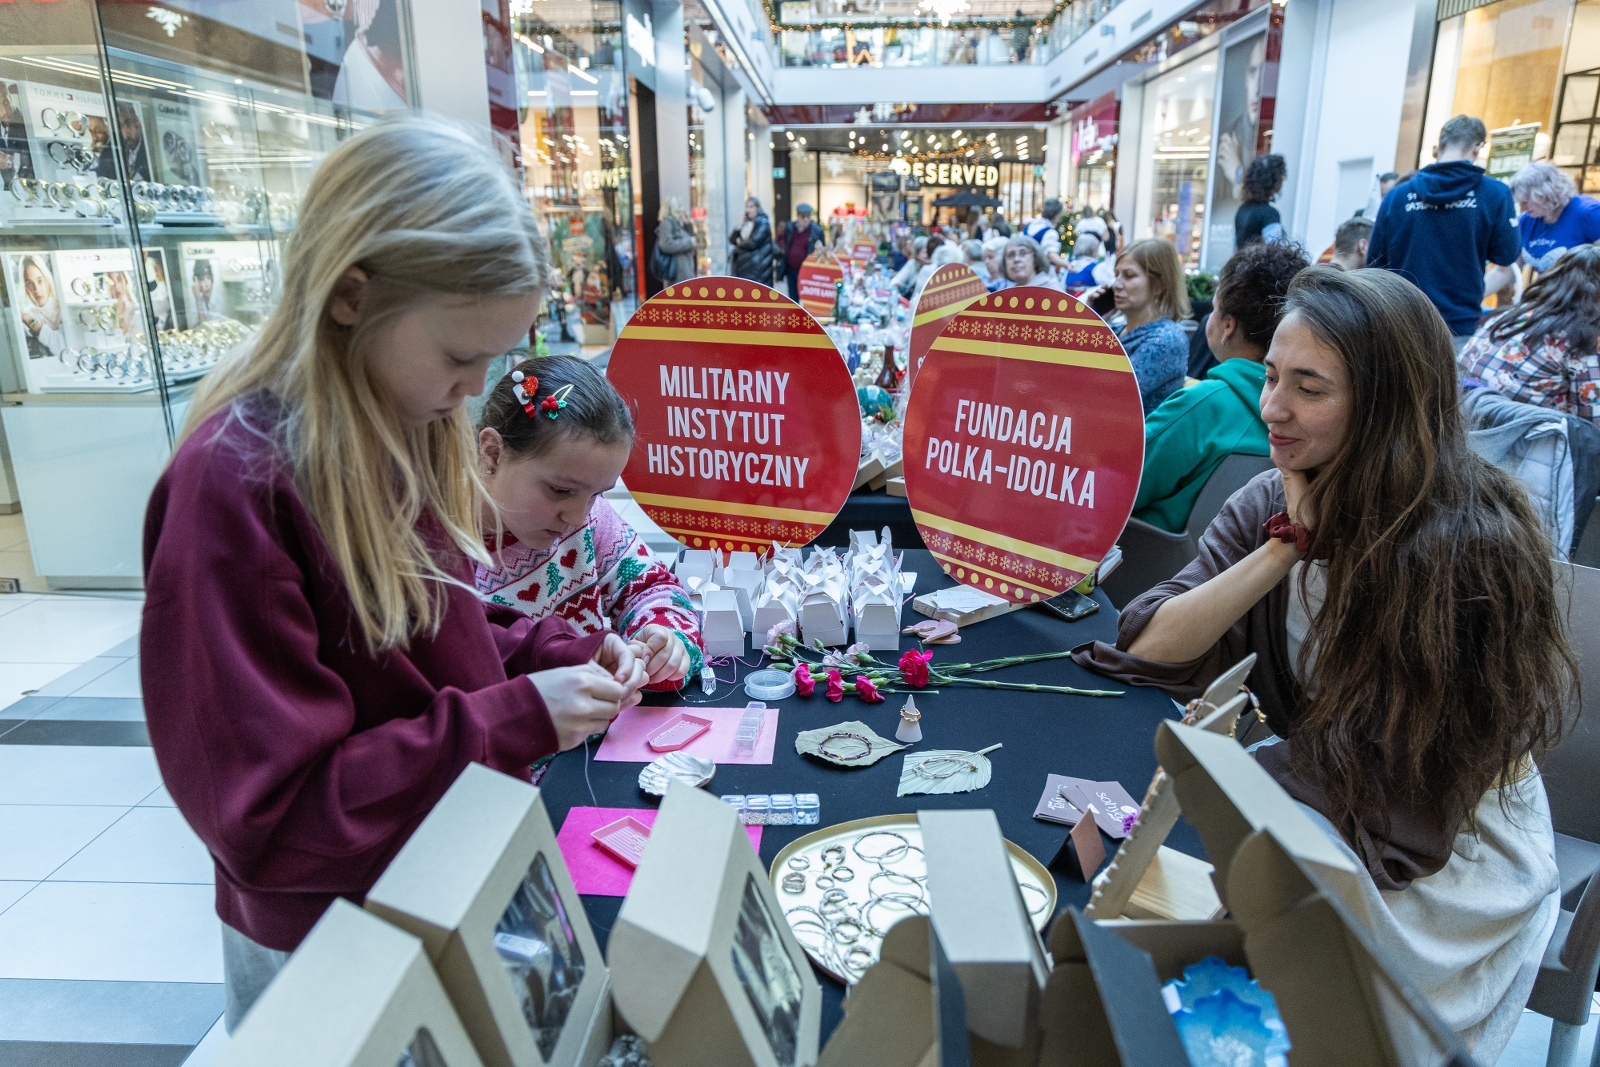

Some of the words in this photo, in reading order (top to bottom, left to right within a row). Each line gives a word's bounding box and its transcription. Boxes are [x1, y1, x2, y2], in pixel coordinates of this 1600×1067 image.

[659, 364, 790, 405] MILITARNY
[667, 405, 785, 446] INSTYTUT
[954, 398, 1072, 455] FUNDACJA
[647, 443, 810, 489] HISTORYCZNY
[925, 436, 1095, 510] POLKA-IDOLKA
